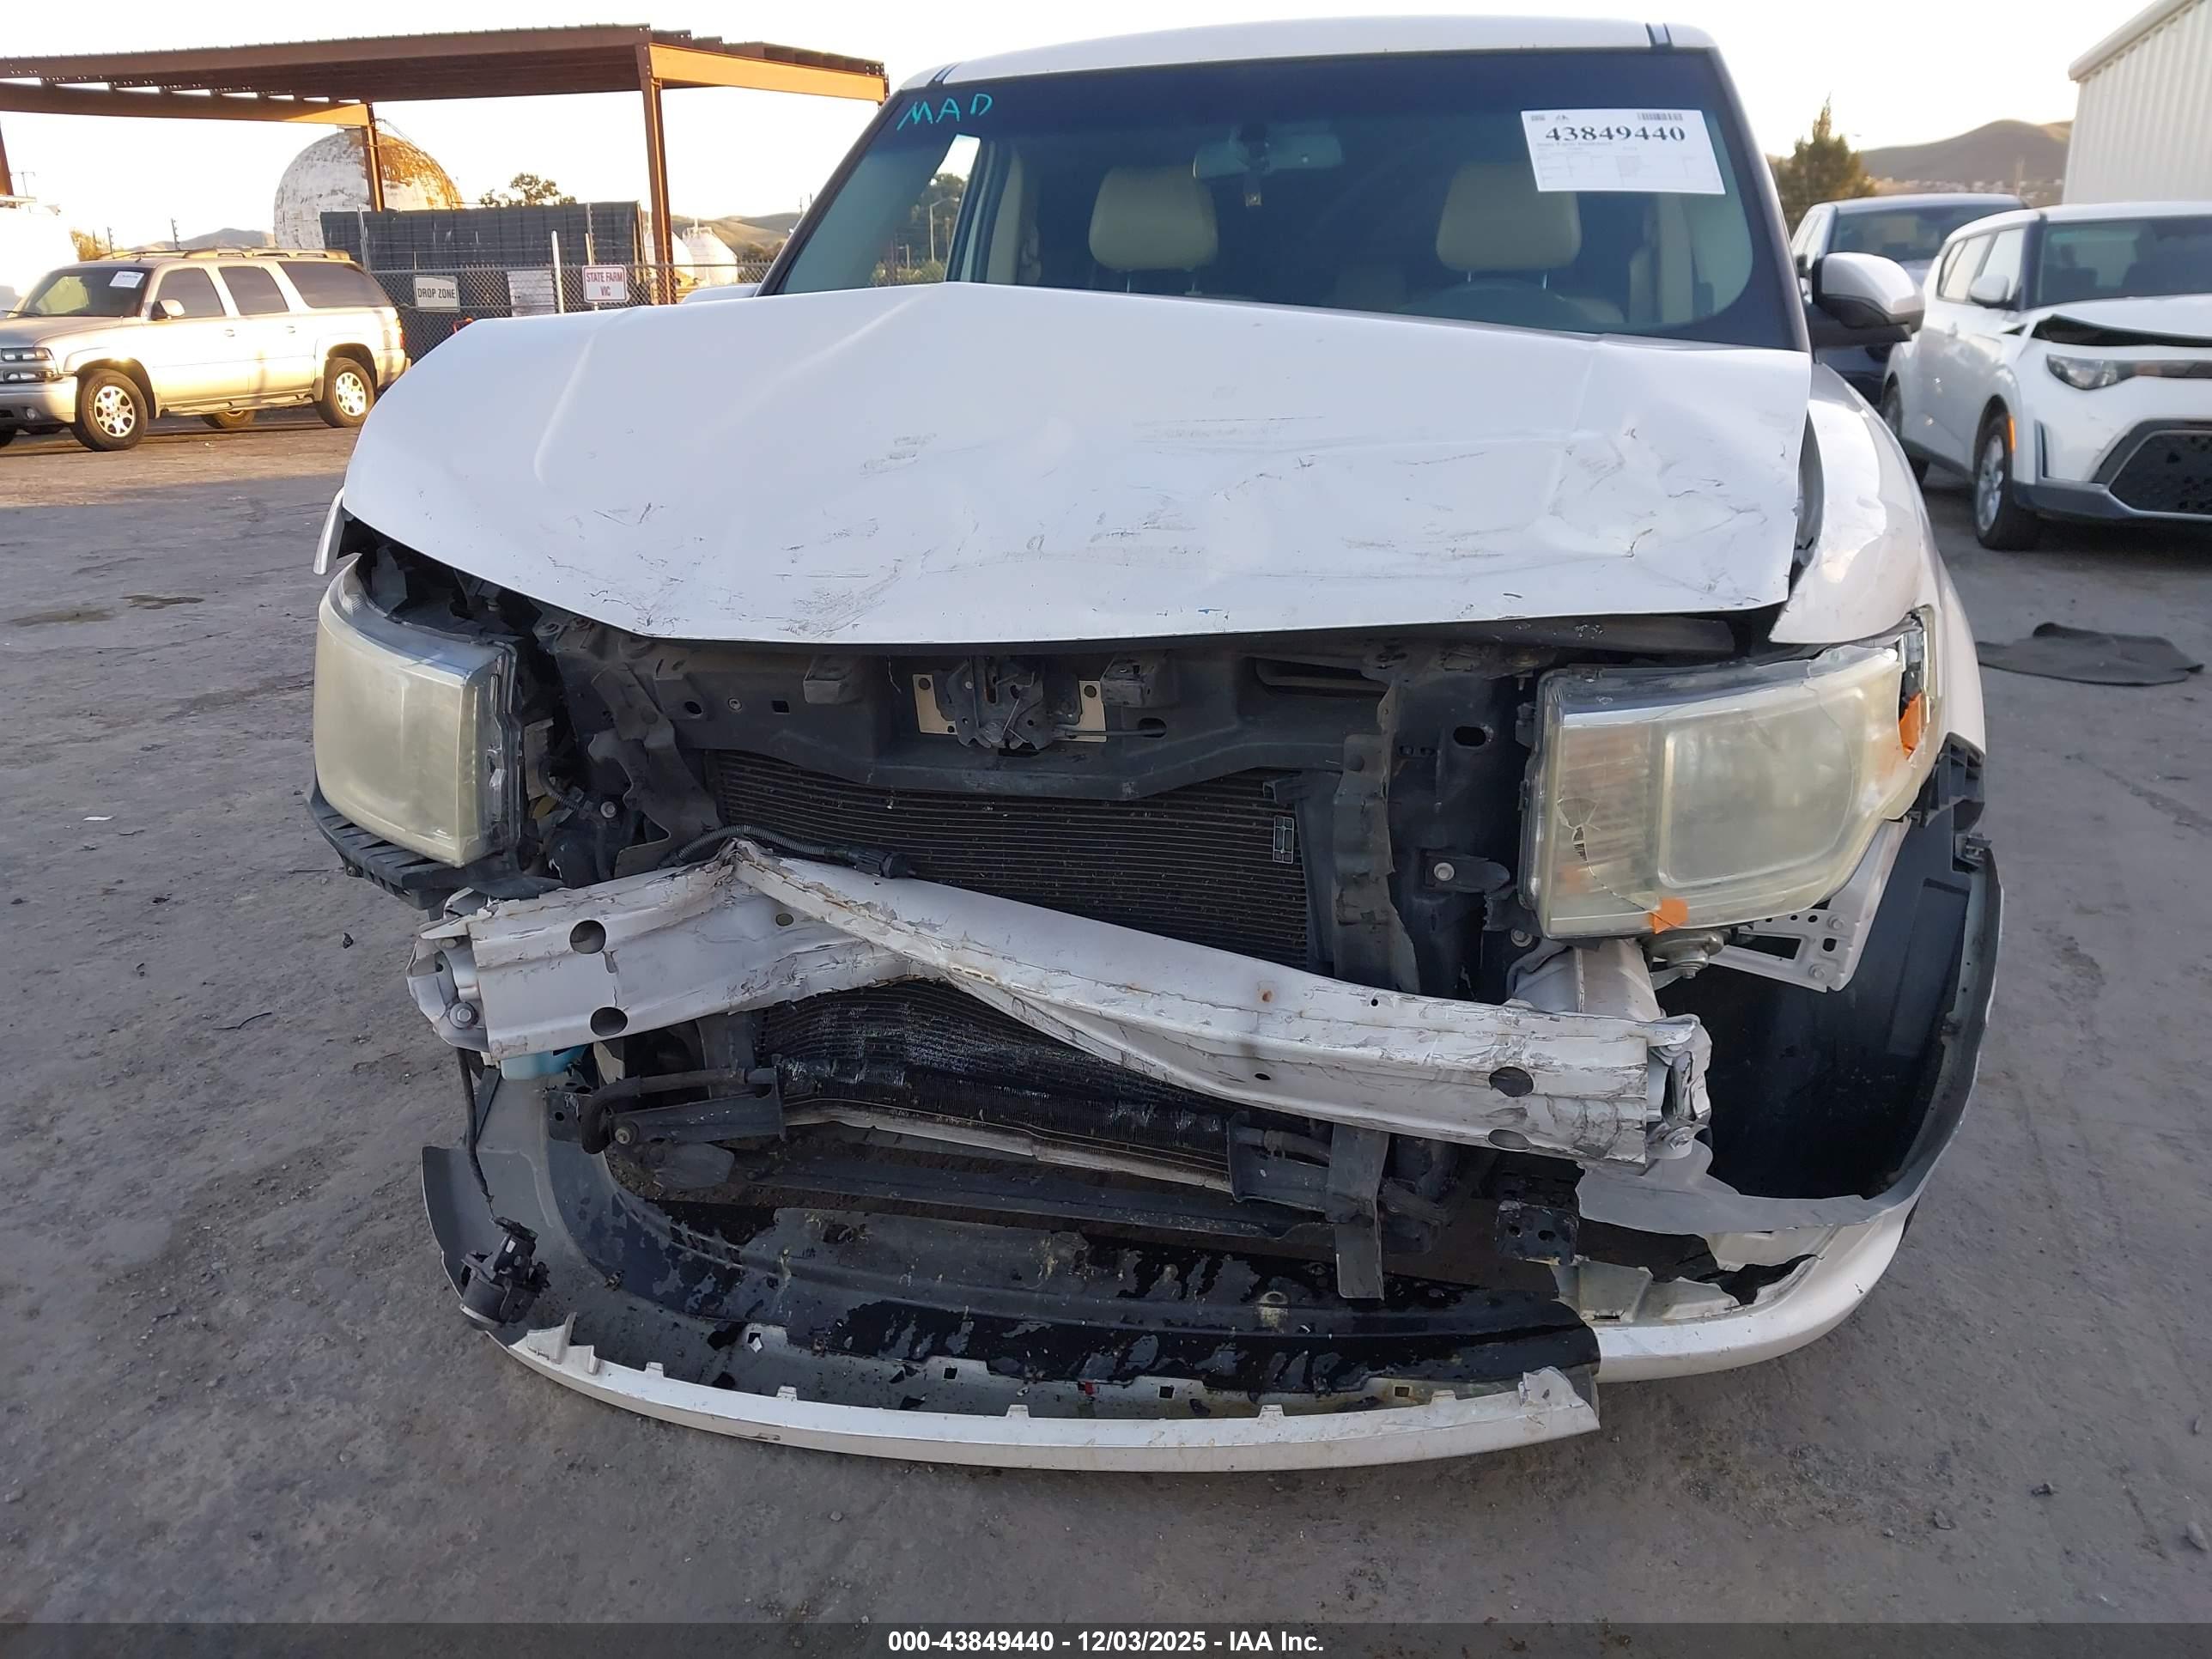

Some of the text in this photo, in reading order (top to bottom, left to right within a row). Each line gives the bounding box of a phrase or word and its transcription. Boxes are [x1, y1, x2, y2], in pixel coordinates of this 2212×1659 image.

[896, 93, 993, 131] MAD
[1545, 125, 1686, 142] 43849440
[586, 271, 623, 283] STATE FARM
[417, 288, 456, 299] DROP ZONE
